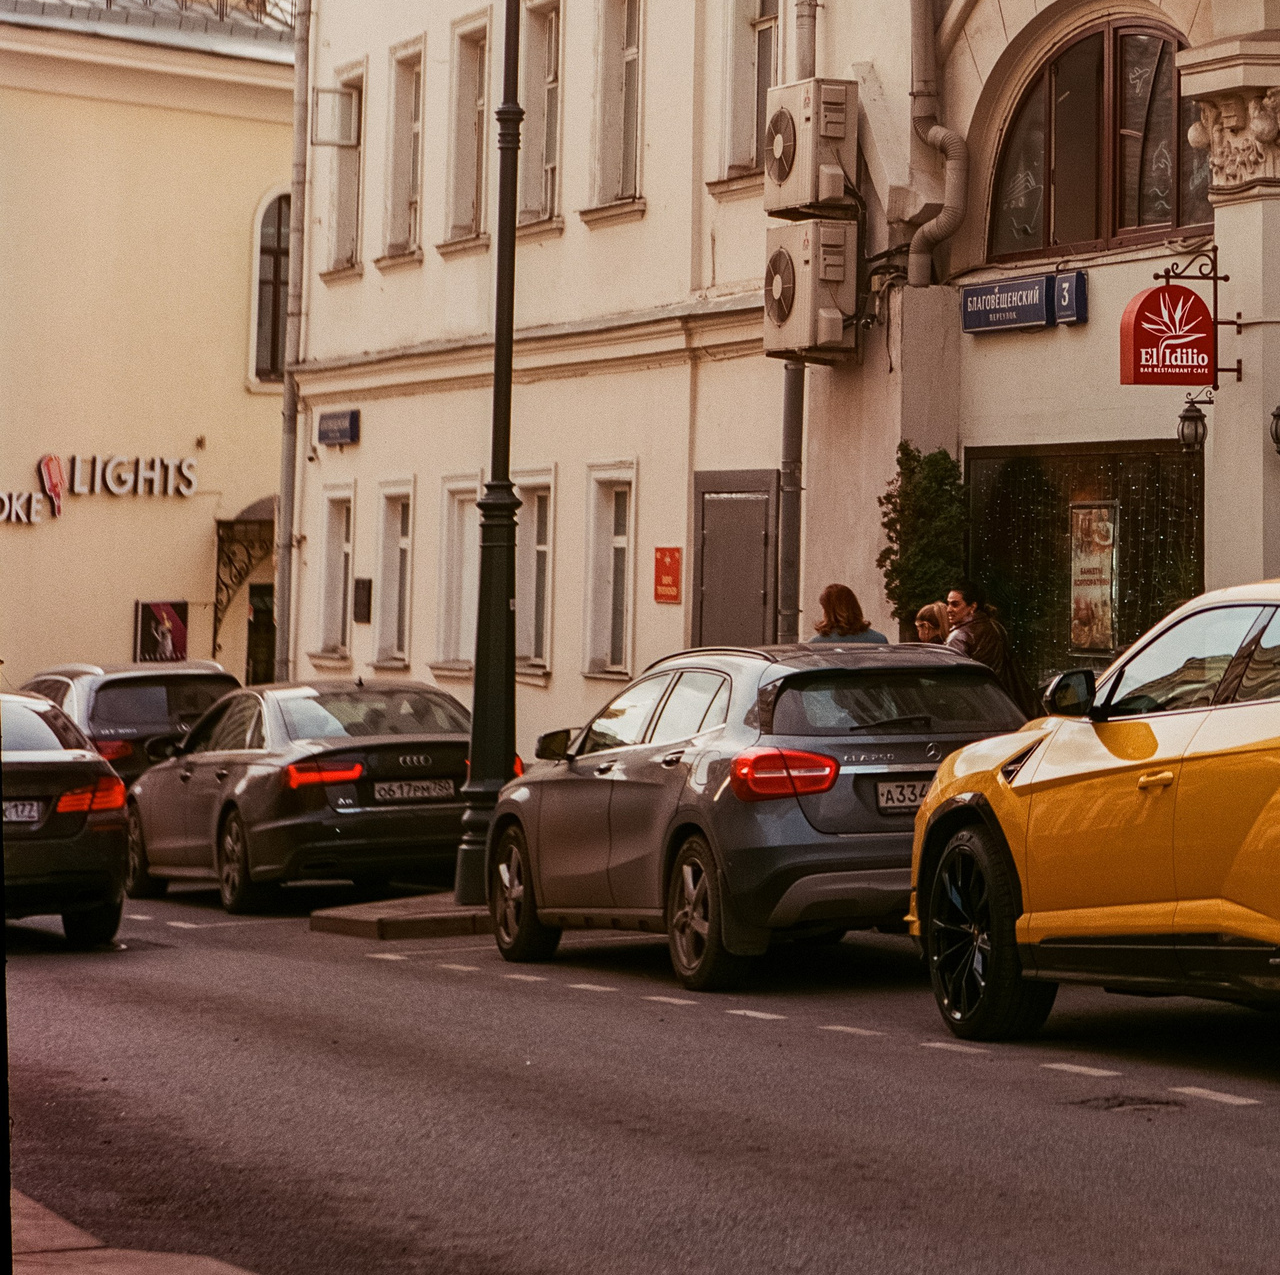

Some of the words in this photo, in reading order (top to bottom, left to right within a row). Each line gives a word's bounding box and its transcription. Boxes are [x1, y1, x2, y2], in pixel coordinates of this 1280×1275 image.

[1061, 282, 1070, 306] 3
[989, 311, 1017, 322] ПЕРЕУЛОК
[1140, 348, 1158, 366] El
[1164, 348, 1209, 366] Idilio
[72, 455, 198, 497] LIGHTS
